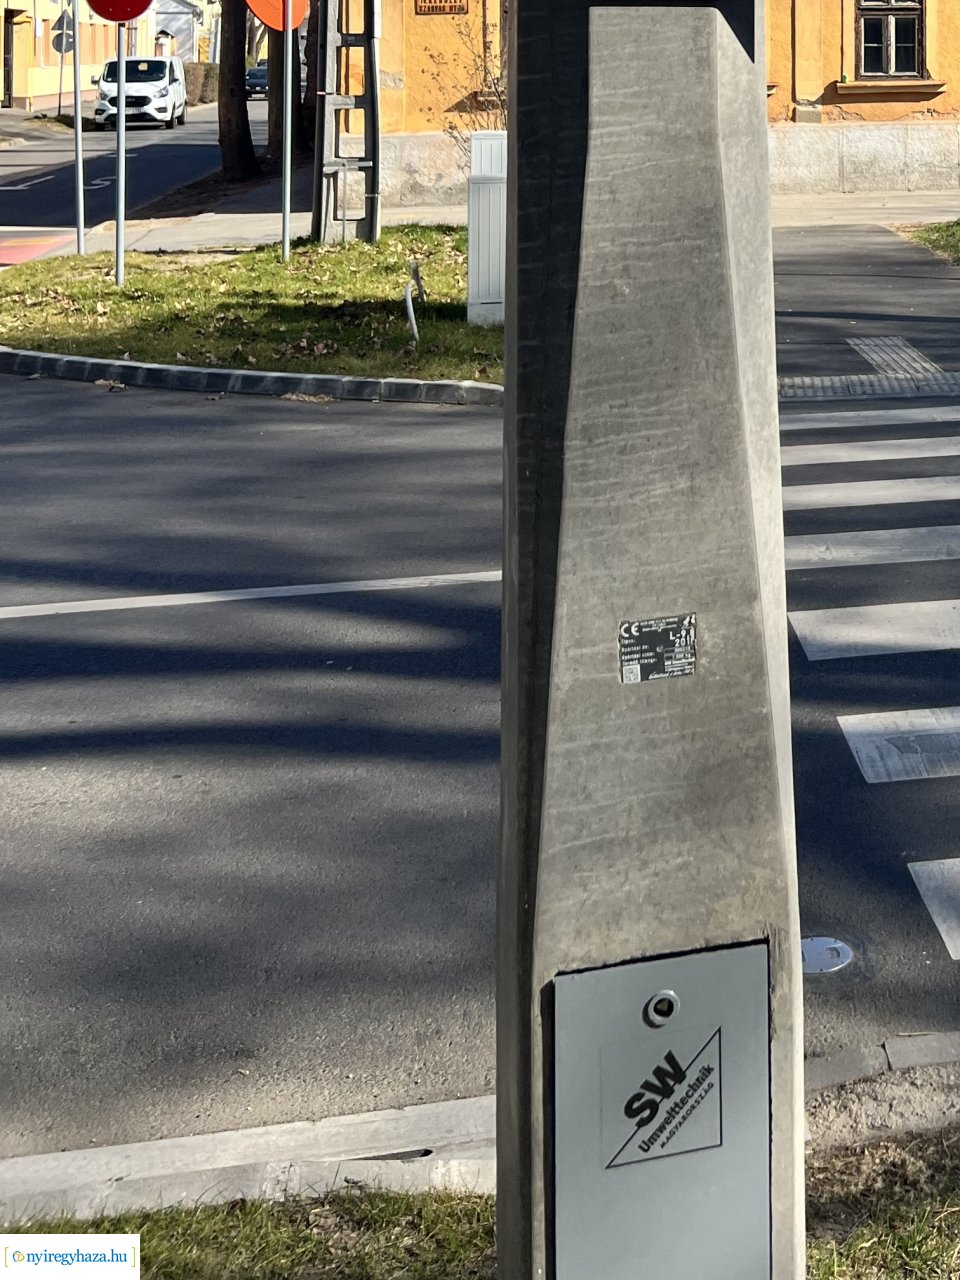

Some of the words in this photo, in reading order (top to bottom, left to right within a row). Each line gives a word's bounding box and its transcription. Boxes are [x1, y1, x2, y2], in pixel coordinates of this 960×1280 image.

[418, 5, 446, 13] SZARVAS
[623, 1049, 687, 1128] SW
[637, 1063, 715, 1154] Umwelttechnik
